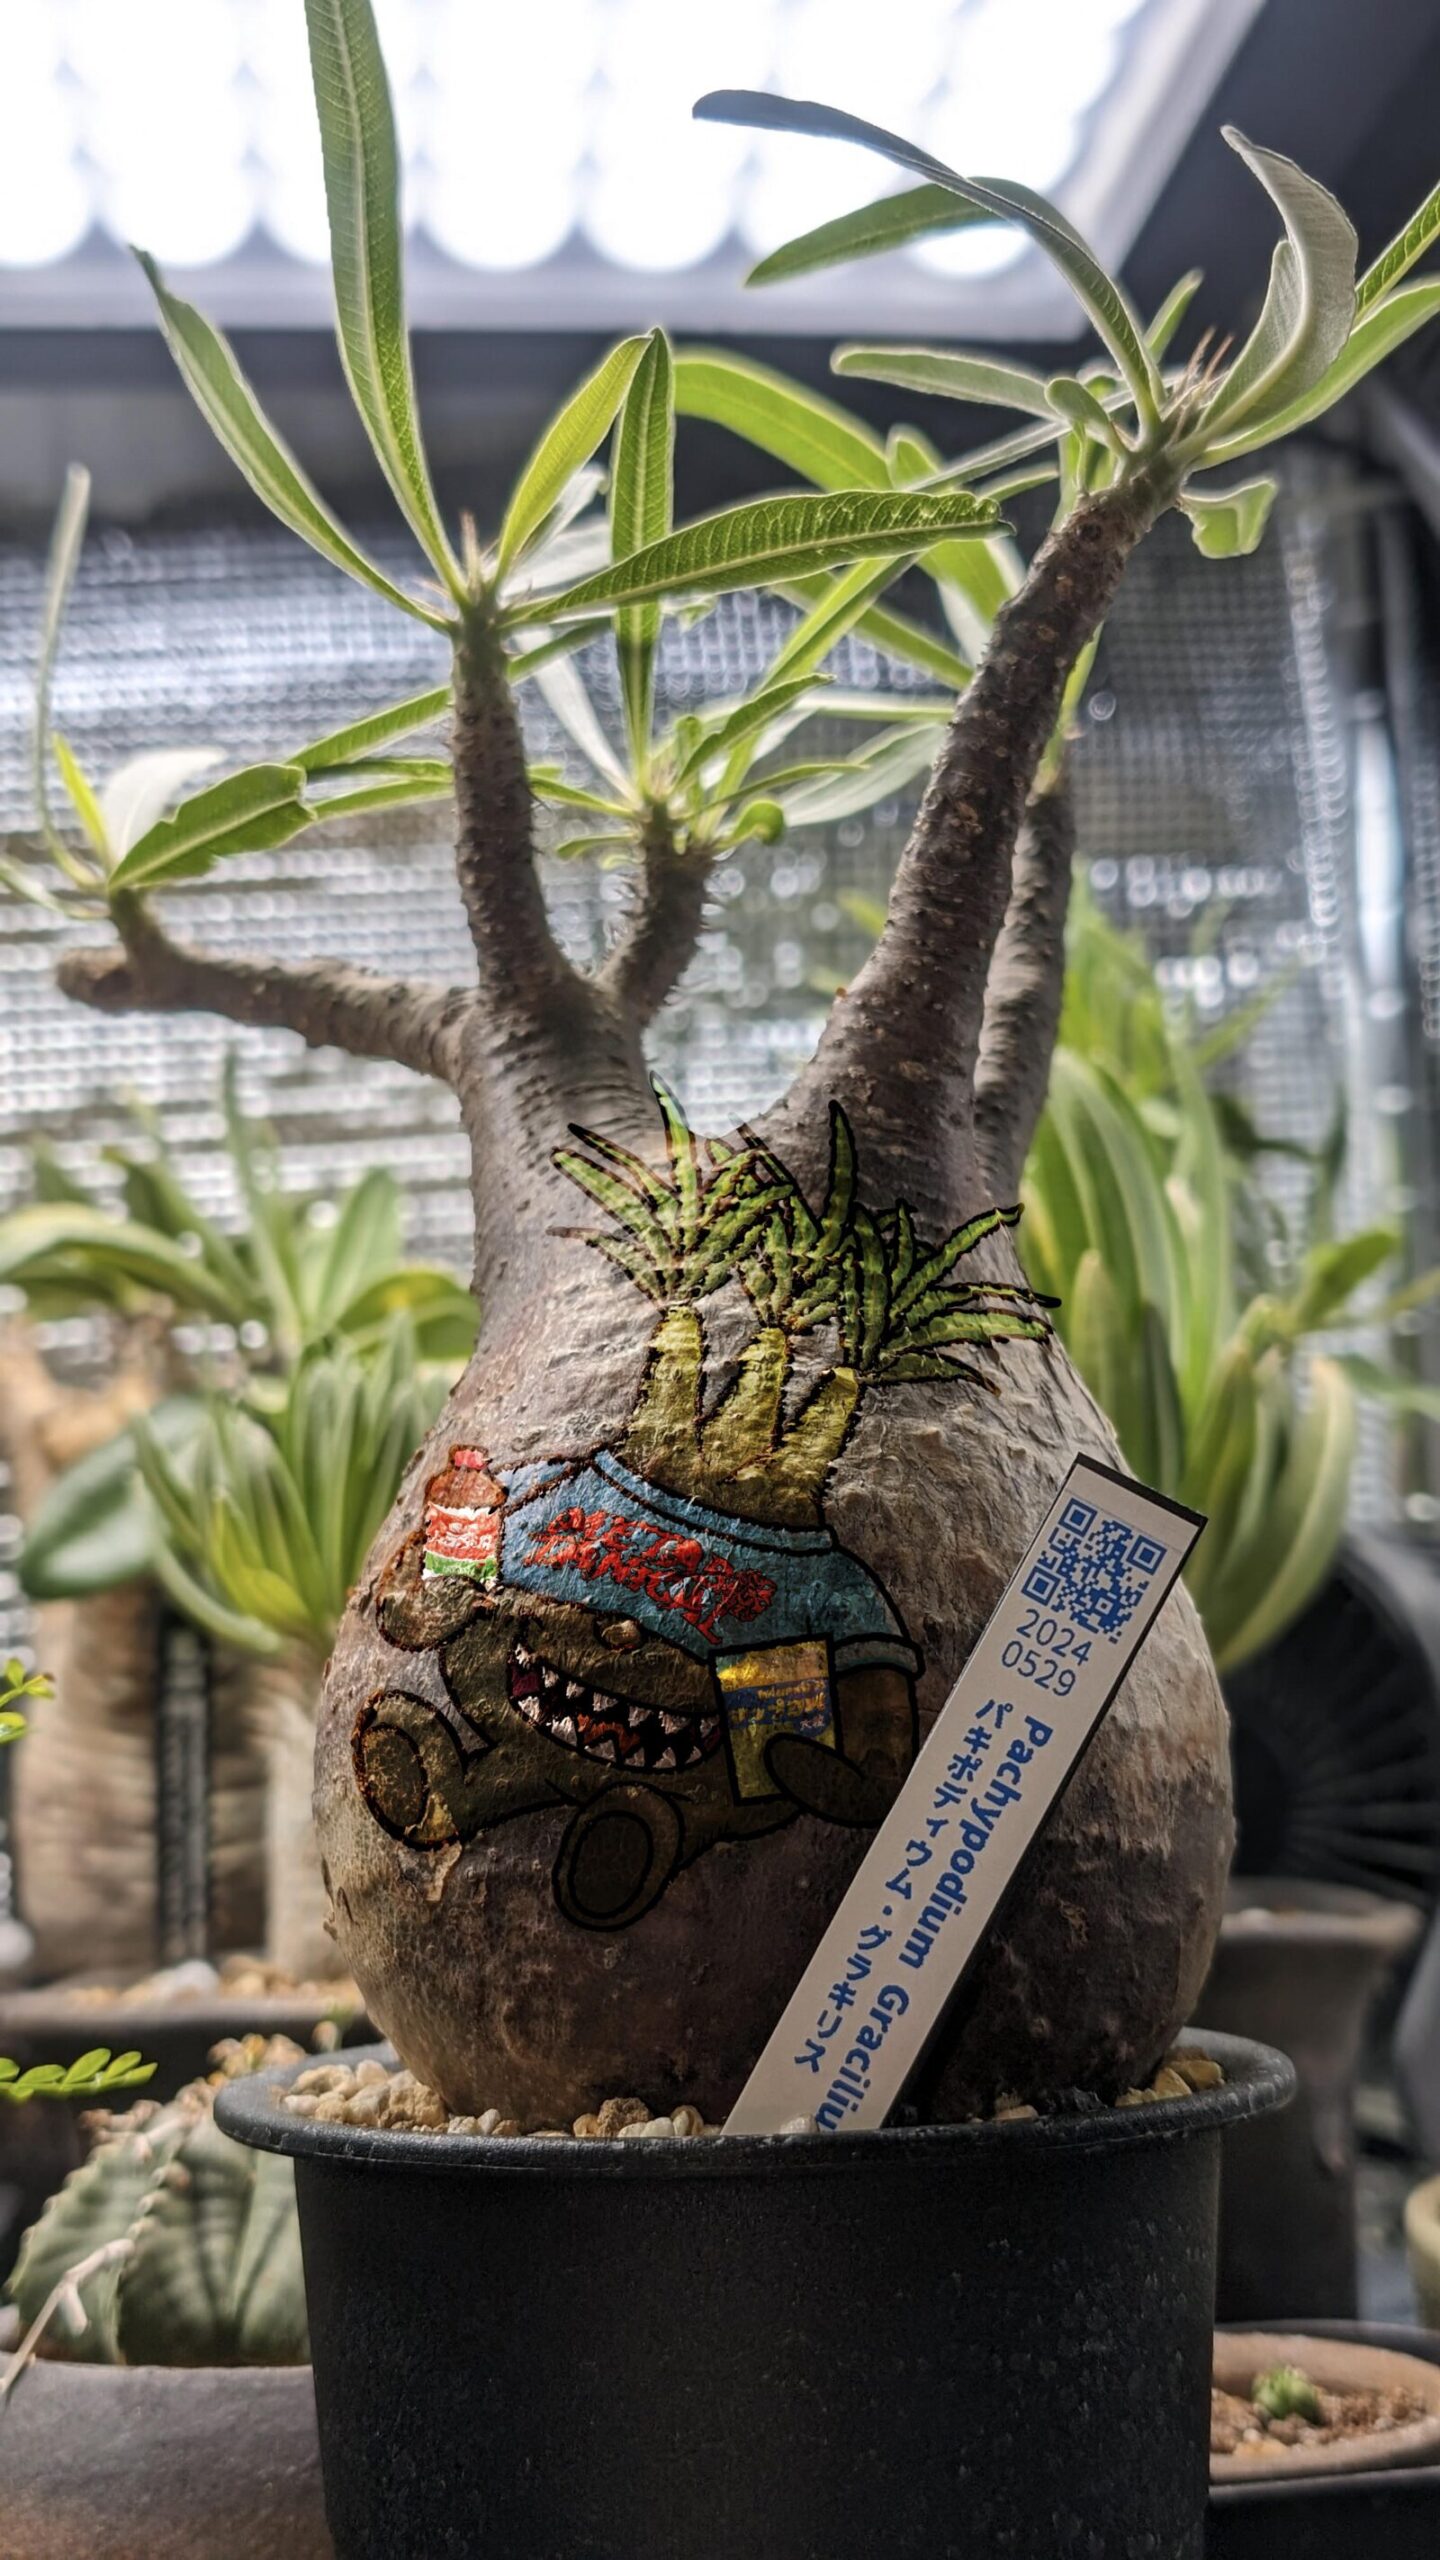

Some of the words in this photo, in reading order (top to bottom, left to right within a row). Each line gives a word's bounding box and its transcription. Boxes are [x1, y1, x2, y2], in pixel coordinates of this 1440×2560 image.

[1015, 1608, 1092, 1666] 2024
[1001, 1640, 1077, 1697] 0529
[898, 1715, 1054, 1970] Pachypodium
